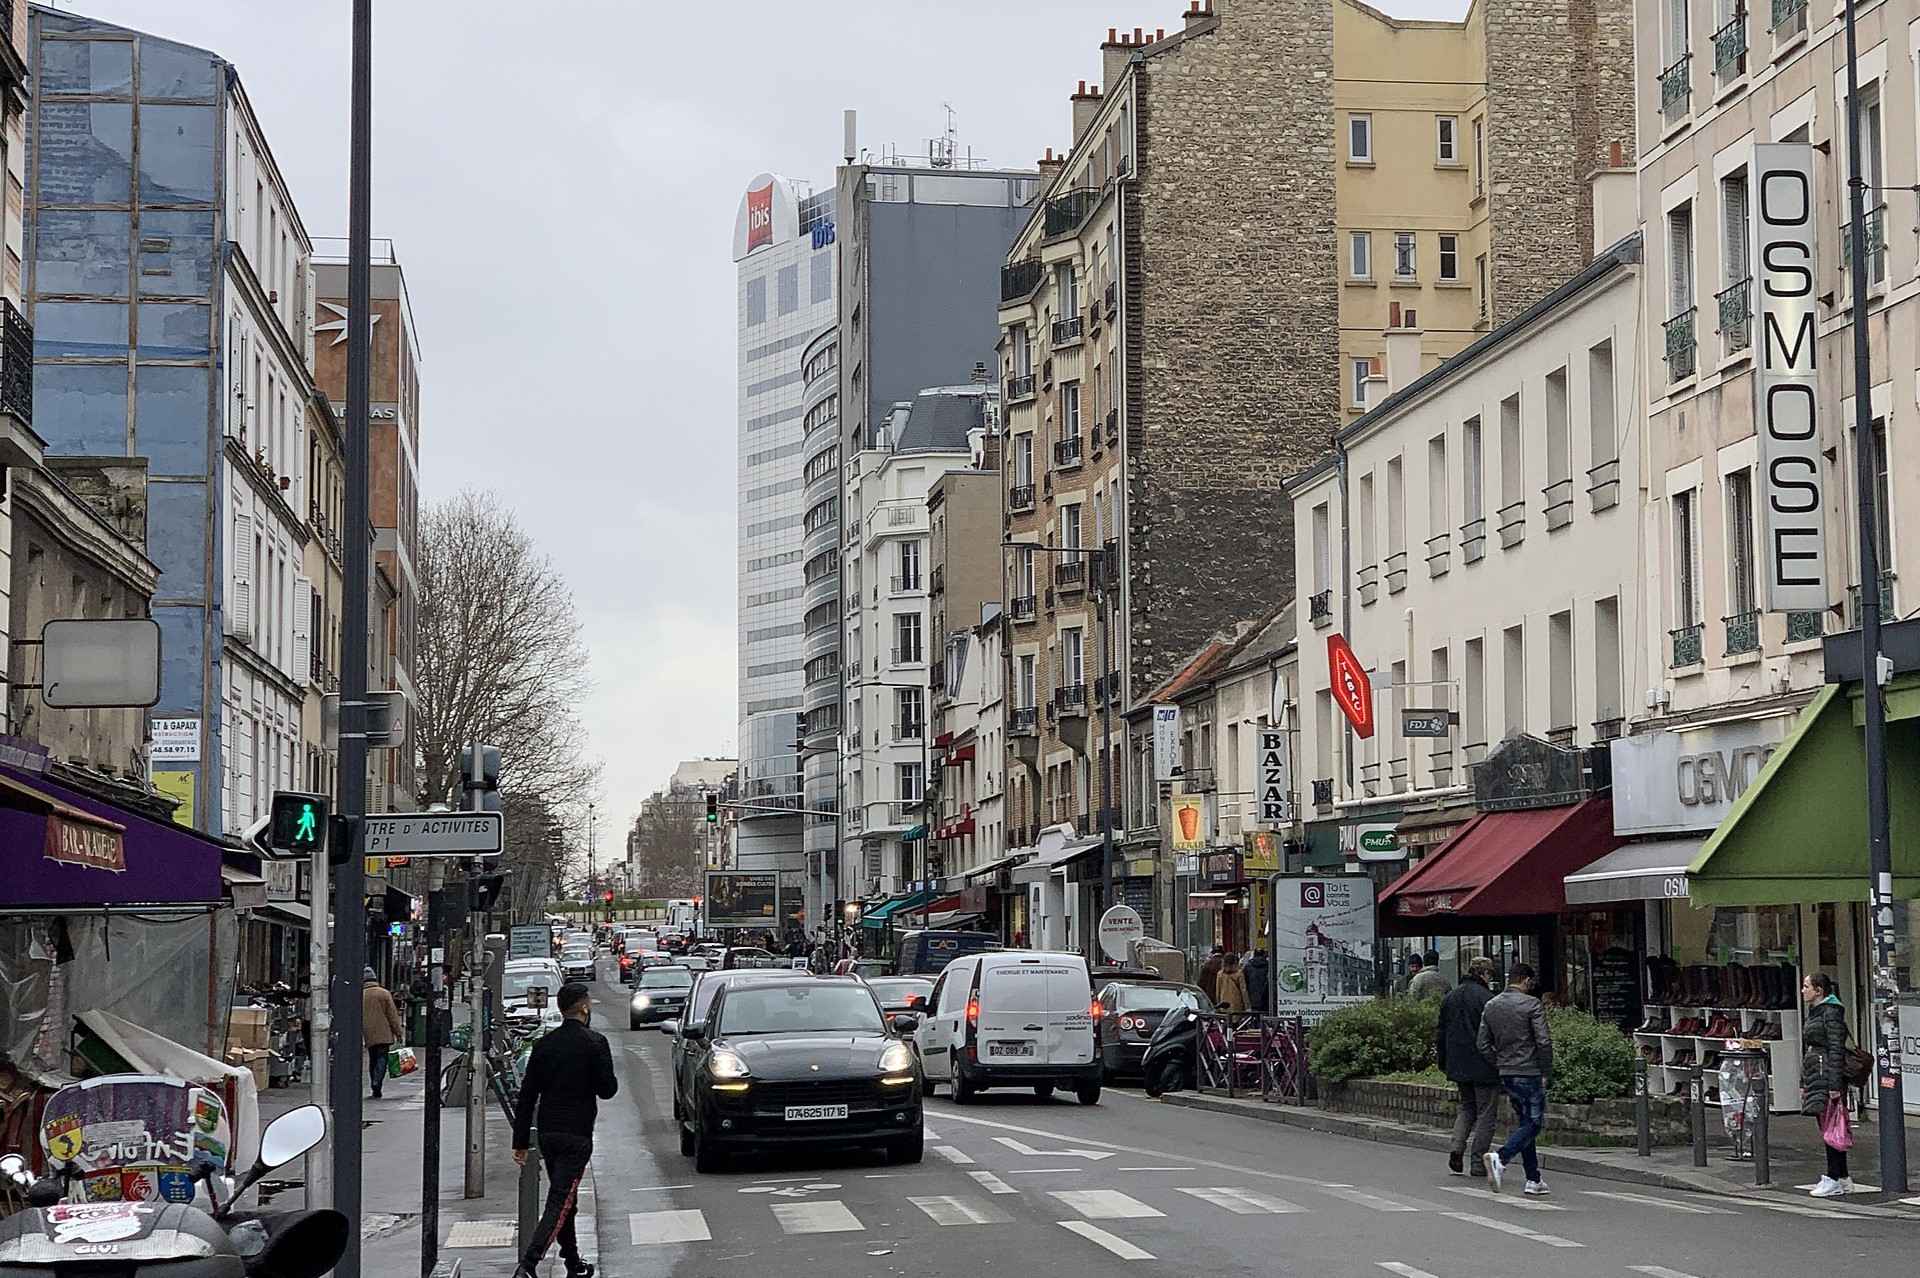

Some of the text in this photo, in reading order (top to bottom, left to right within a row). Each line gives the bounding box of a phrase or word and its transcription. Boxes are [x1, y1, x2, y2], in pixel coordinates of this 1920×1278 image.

[751, 202, 770, 229] ibis
[811, 222, 836, 250] ibis
[1760, 169, 1821, 587] OSMOSE
[1341, 660, 1361, 711] TABAC
[163, 721, 168, 730] &
[170, 721, 197, 730] GAPAIX
[1409, 720, 1428, 729] FDJ
[1262, 733, 1283, 820] BAZAR
[1677, 743, 1785, 806] OSMO
[422, 821, 490, 834] ACTIVITES
[1364, 838, 1385, 847] PMU
[1326, 883, 1350, 892] Toit
[1326, 899, 1350, 907] Vous
[74, 1244, 119, 1254] GIVI
